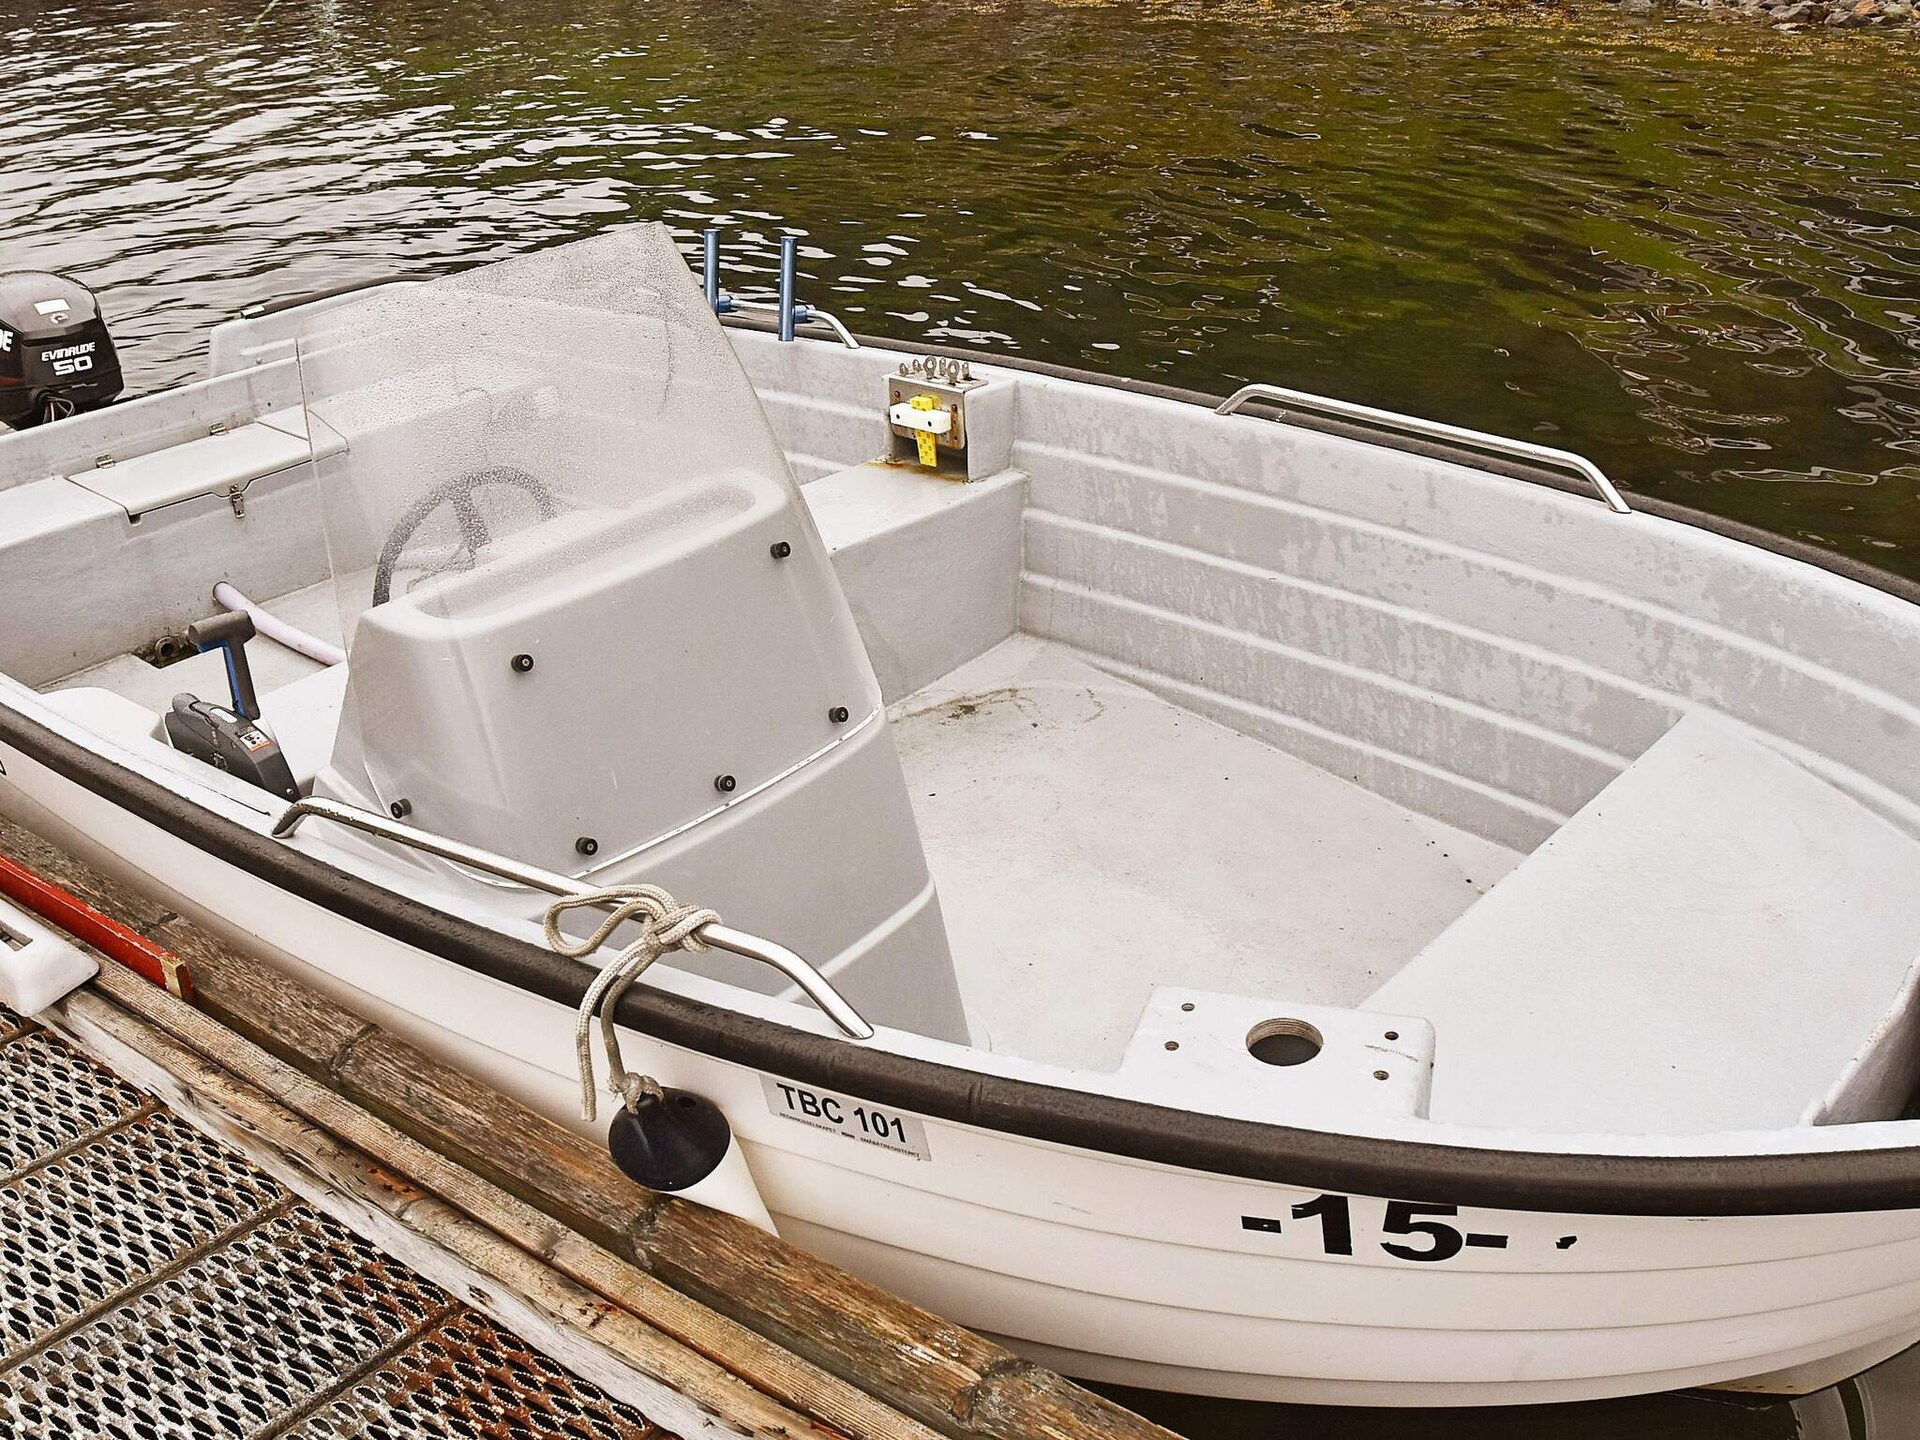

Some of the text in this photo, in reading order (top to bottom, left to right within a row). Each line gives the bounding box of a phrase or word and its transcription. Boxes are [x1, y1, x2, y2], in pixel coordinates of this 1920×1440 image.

[41, 342, 95, 361] EVINRUDE
[53, 356, 93, 375] 50
[776, 1082, 844, 1124] TBC
[853, 1107, 906, 1143] 101
